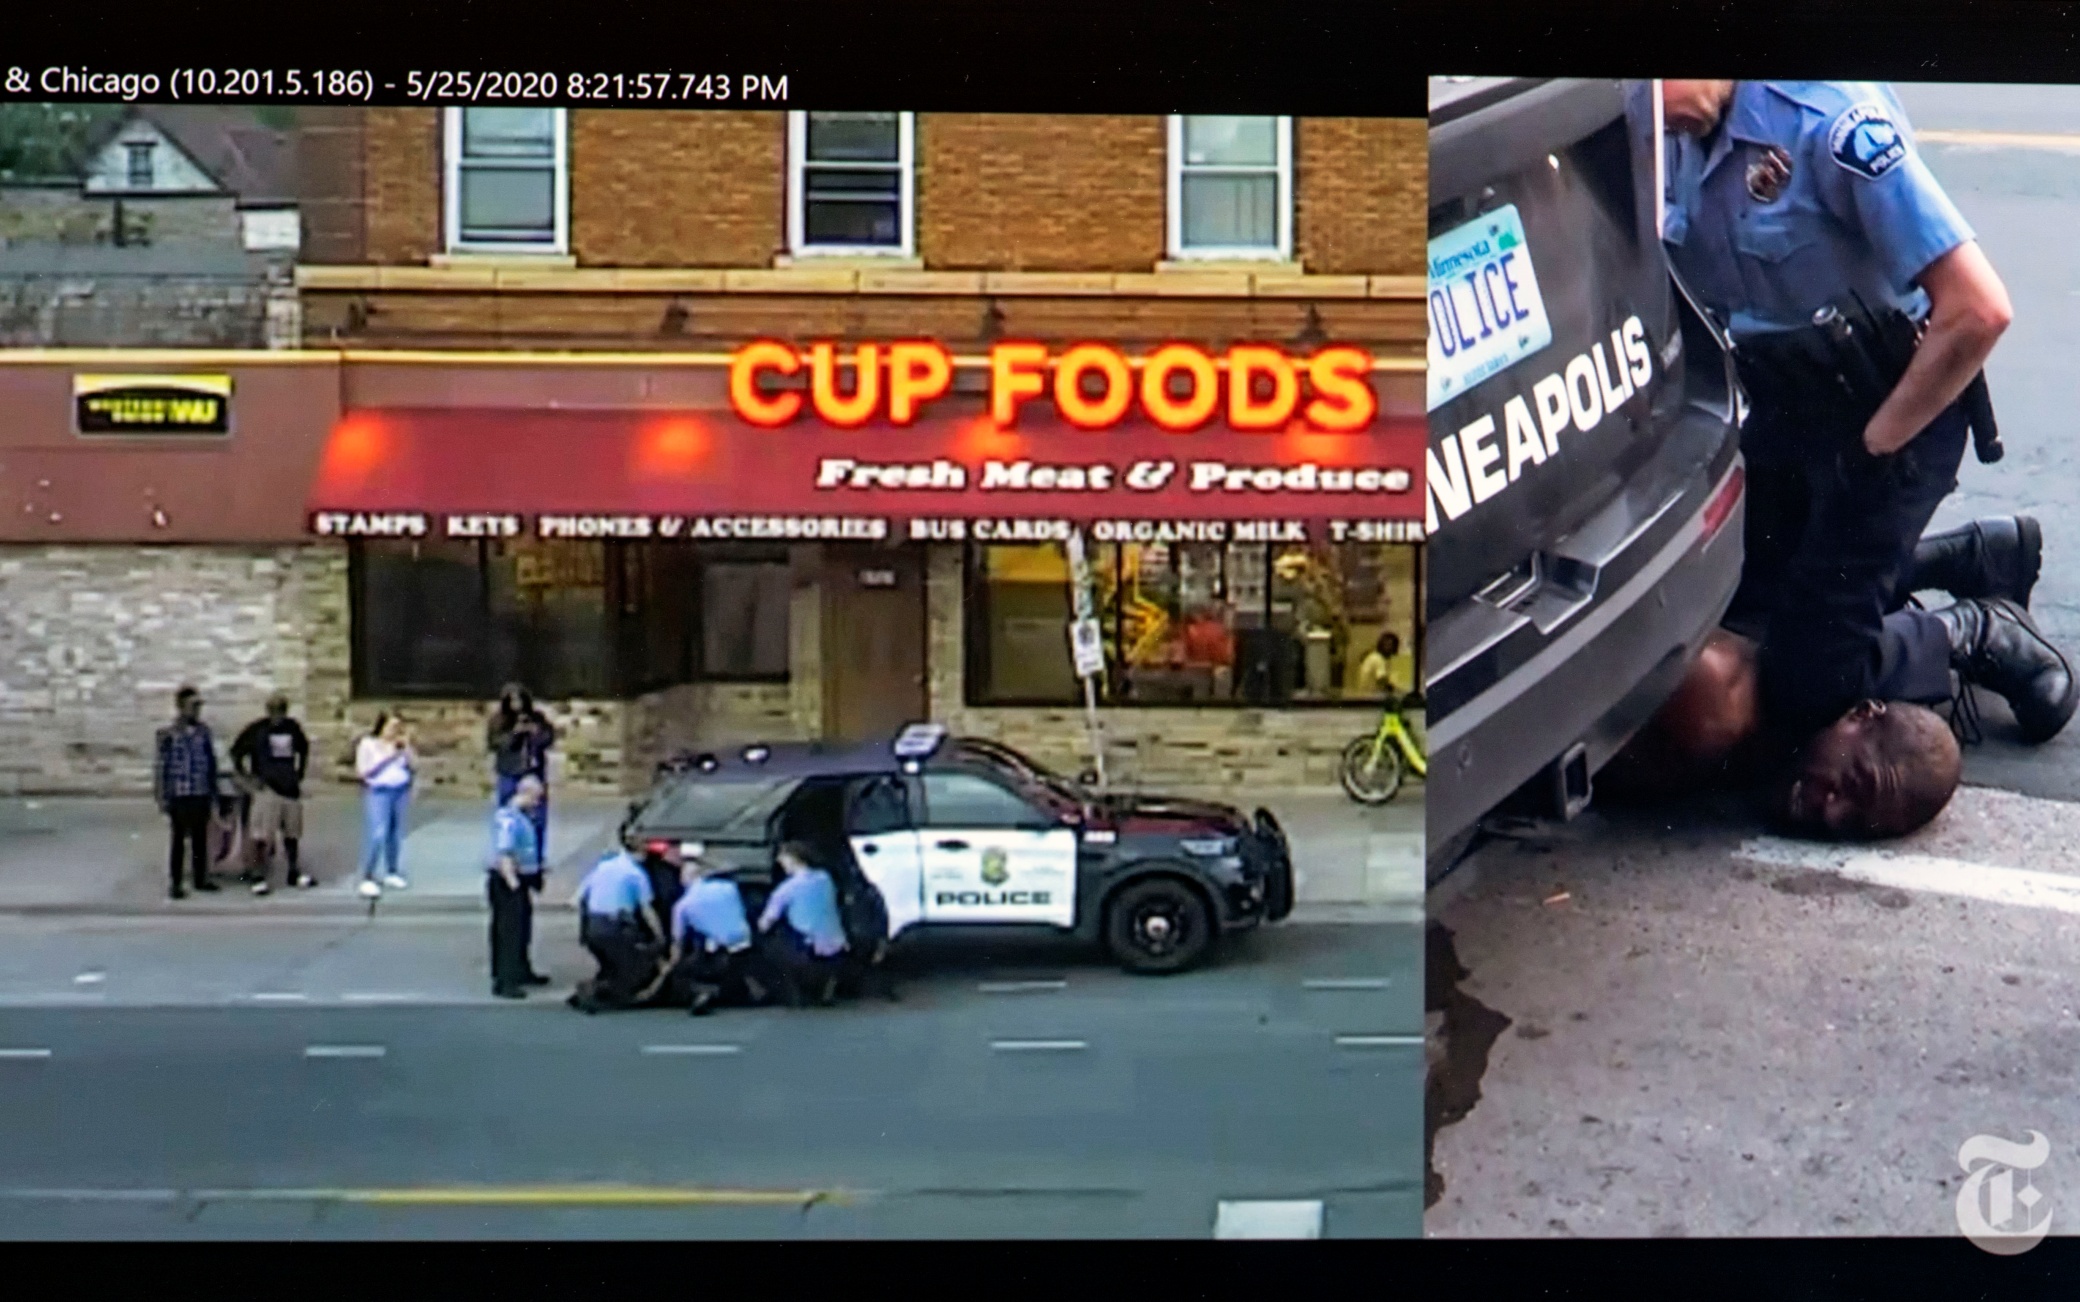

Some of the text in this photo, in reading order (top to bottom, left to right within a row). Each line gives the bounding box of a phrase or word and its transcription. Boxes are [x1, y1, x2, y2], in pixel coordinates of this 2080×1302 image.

[4, 66, 31, 93] &
[40, 66, 161, 100] Chicago
[169, 68, 374, 100] (10.201.5.186)
[406, 70, 558, 100] 5/25/2020
[566, 73, 731, 100] 8:21:57.743
[743, 75, 789, 101] PM
[729, 341, 1378, 433] CUP FOODS
[816, 458, 1410, 490] Fresh Meat & Produce
[317, 514, 426, 535] STAMPS
[539, 517, 650, 537] PHONES
[658, 518, 683, 536] &
[690, 518, 887, 538] ACCESSORIES
[910, 519, 965, 539] BUS
[972, 520, 1070, 540] CARDS
[1094, 521, 1226, 541] ORGANIC
[1231, 521, 1308, 541] MILK
[936, 892, 1053, 906] POLICE
